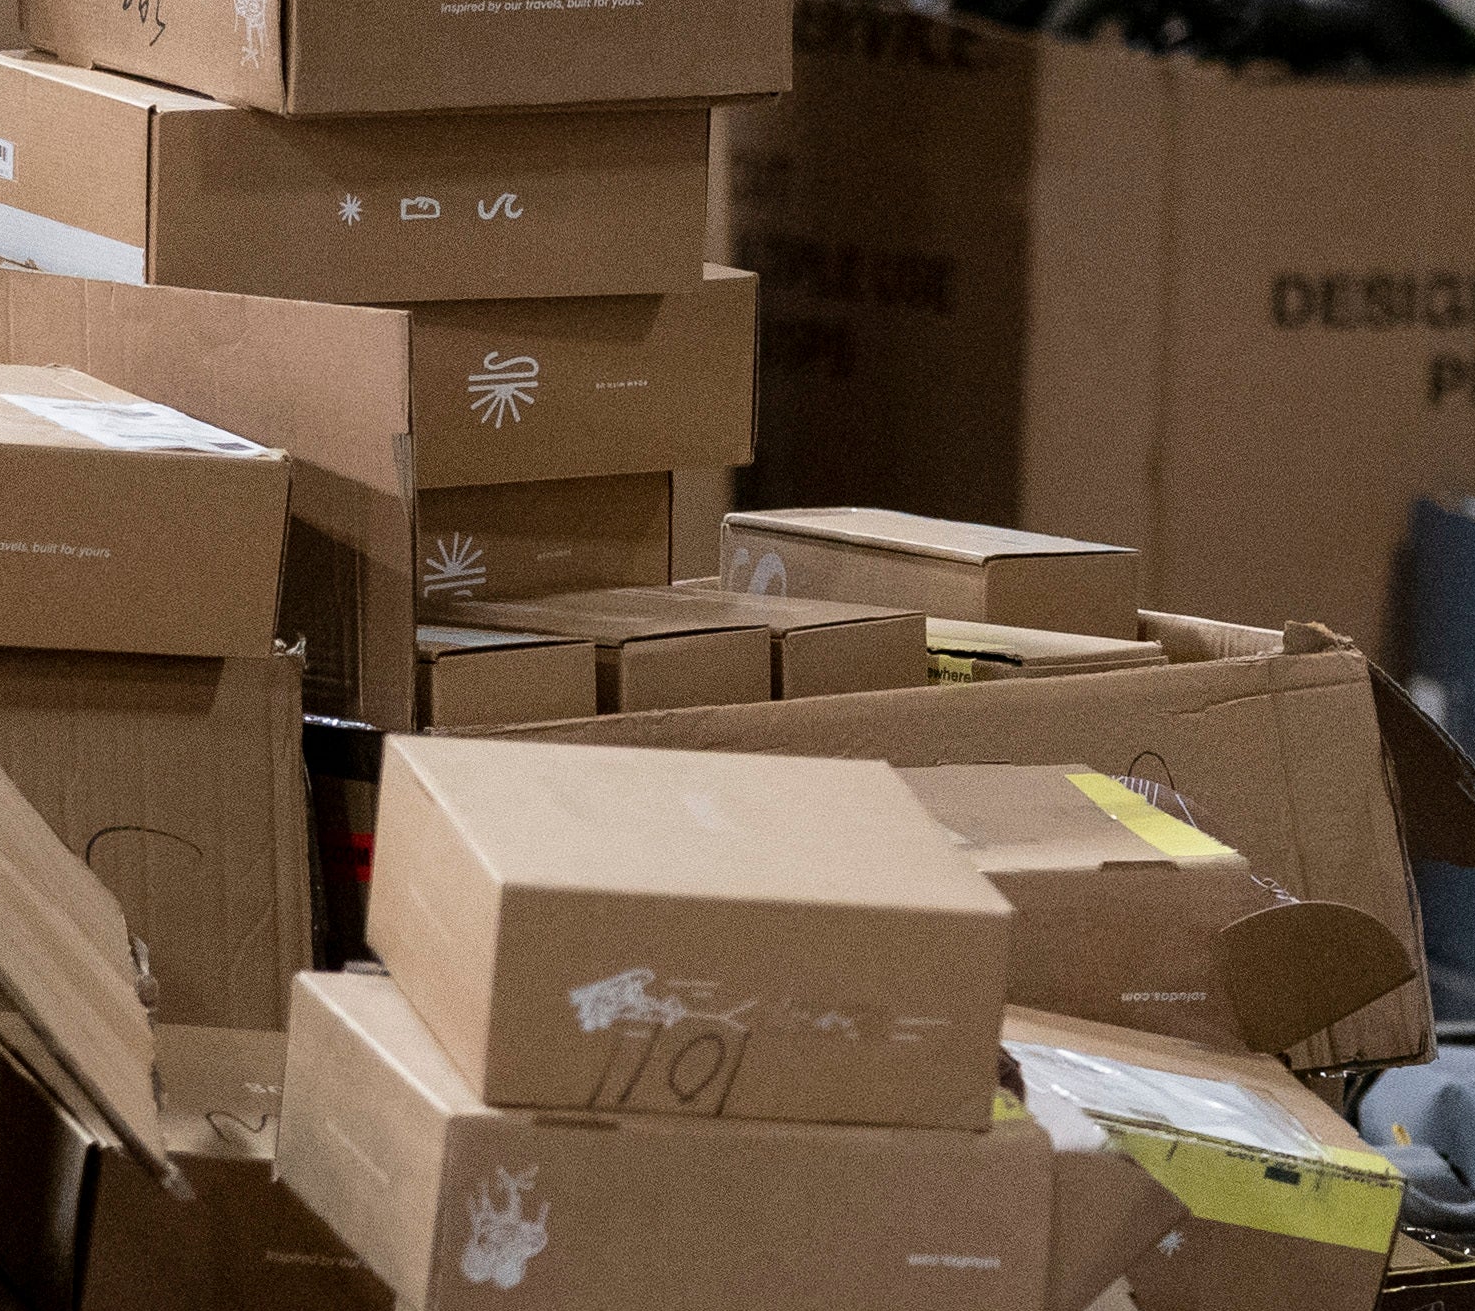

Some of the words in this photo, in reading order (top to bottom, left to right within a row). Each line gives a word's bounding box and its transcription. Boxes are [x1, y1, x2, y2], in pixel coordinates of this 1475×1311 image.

[440, 1, 485, 15] Inspired
[488, 0, 500, 14] by
[504, 2, 523, 11] our
[33, 542, 57, 554] built
[60, 543, 77, 555] for
